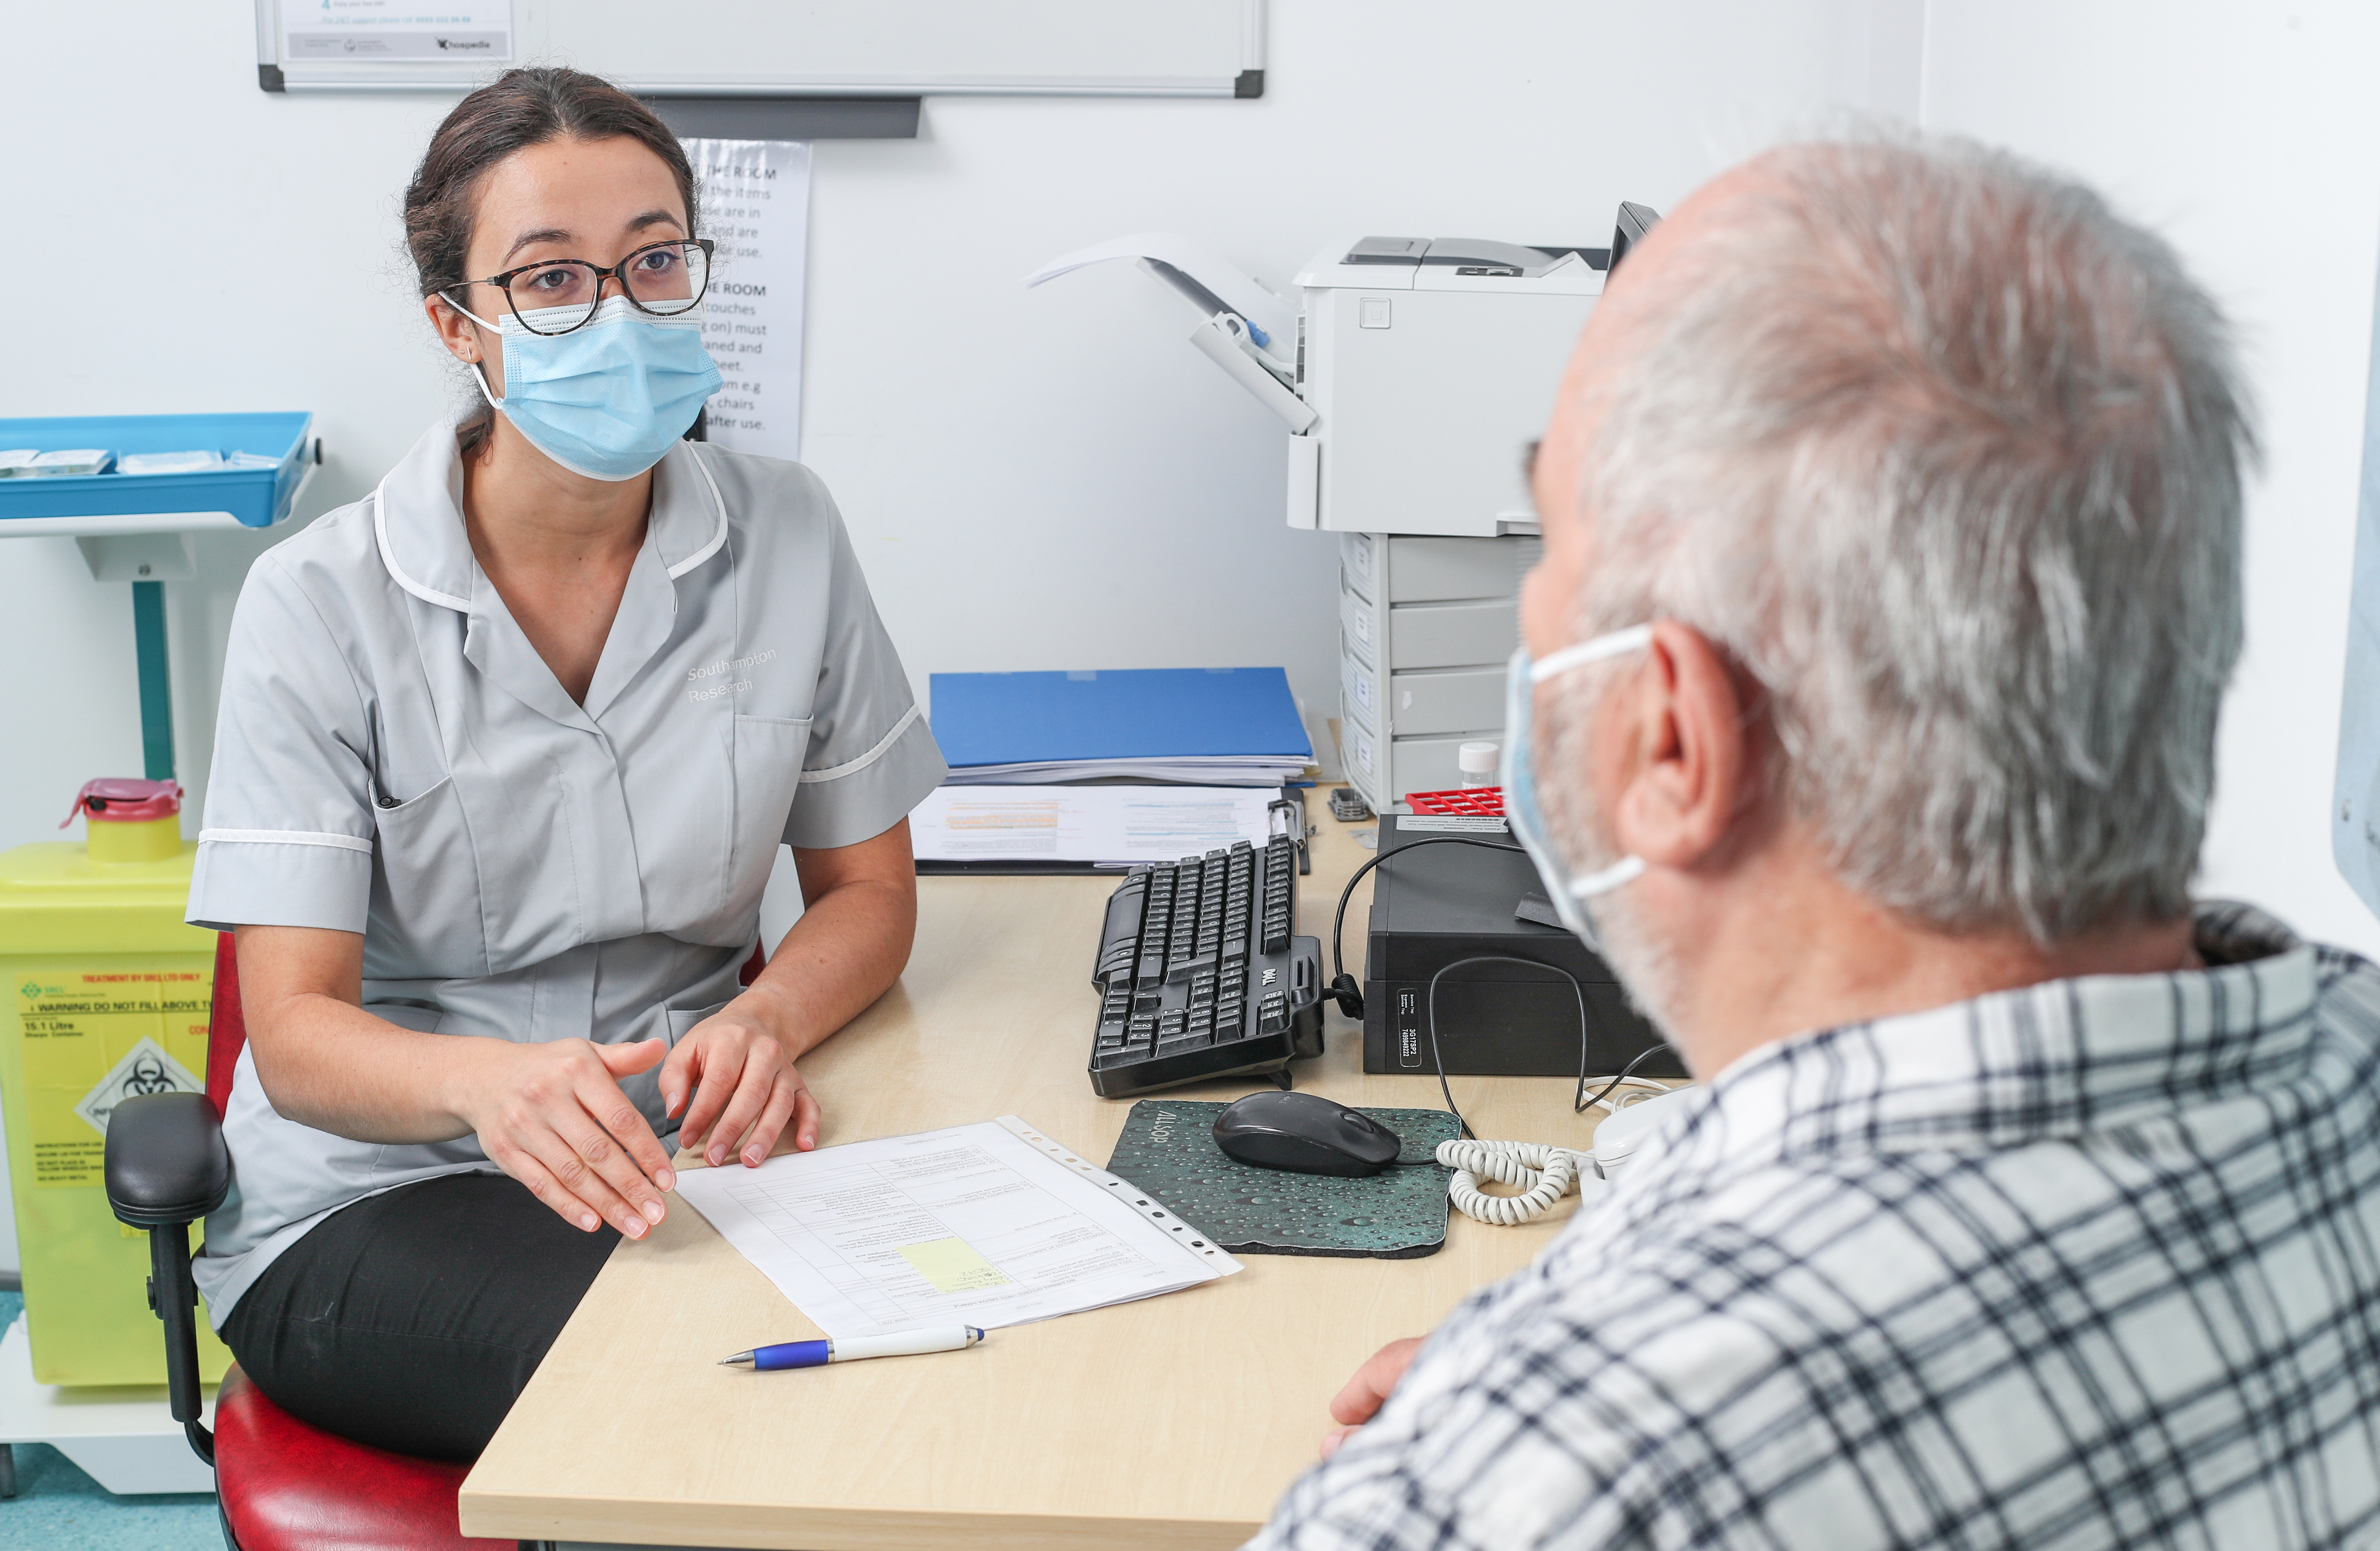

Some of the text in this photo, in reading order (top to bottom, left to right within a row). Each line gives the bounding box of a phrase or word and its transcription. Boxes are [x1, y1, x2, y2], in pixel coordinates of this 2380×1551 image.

[448, 40, 490, 49] hospedia
[734, 166, 777, 180] ROOM
[735, 187, 771, 200] items
[725, 208, 745, 218] are
[748, 206, 761, 218] in
[738, 229, 758, 238] are
[737, 249, 763, 258] use.
[706, 283, 766, 297] HE ROOM
[710, 322, 732, 334] on)
[735, 323, 767, 336] must
[704, 341, 762, 354] aned and
[715, 359, 744, 372] heet.
[742, 383, 761, 394] e.g
[717, 397, 755, 410] chairs
[706, 415, 766, 431] after use.
[688, 649, 777, 681] Southampton
[688, 679, 753, 703] Research
[82, 975, 129, 983] TREATMENT
[1261, 968, 1277, 987] DELL
[38, 1003, 91, 1012] WARNING
[94, 1003, 110, 1011] DO
[113, 1002, 136, 1011] NOT
[139, 1002, 158, 1010] FILL
[161, 1001, 199, 1010] ABOVE
[50, 1021, 74, 1030] Litre
[1149, 1110, 1177, 1143] ALLSOP
[955, 1169, 996, 1179] Reimbursement
